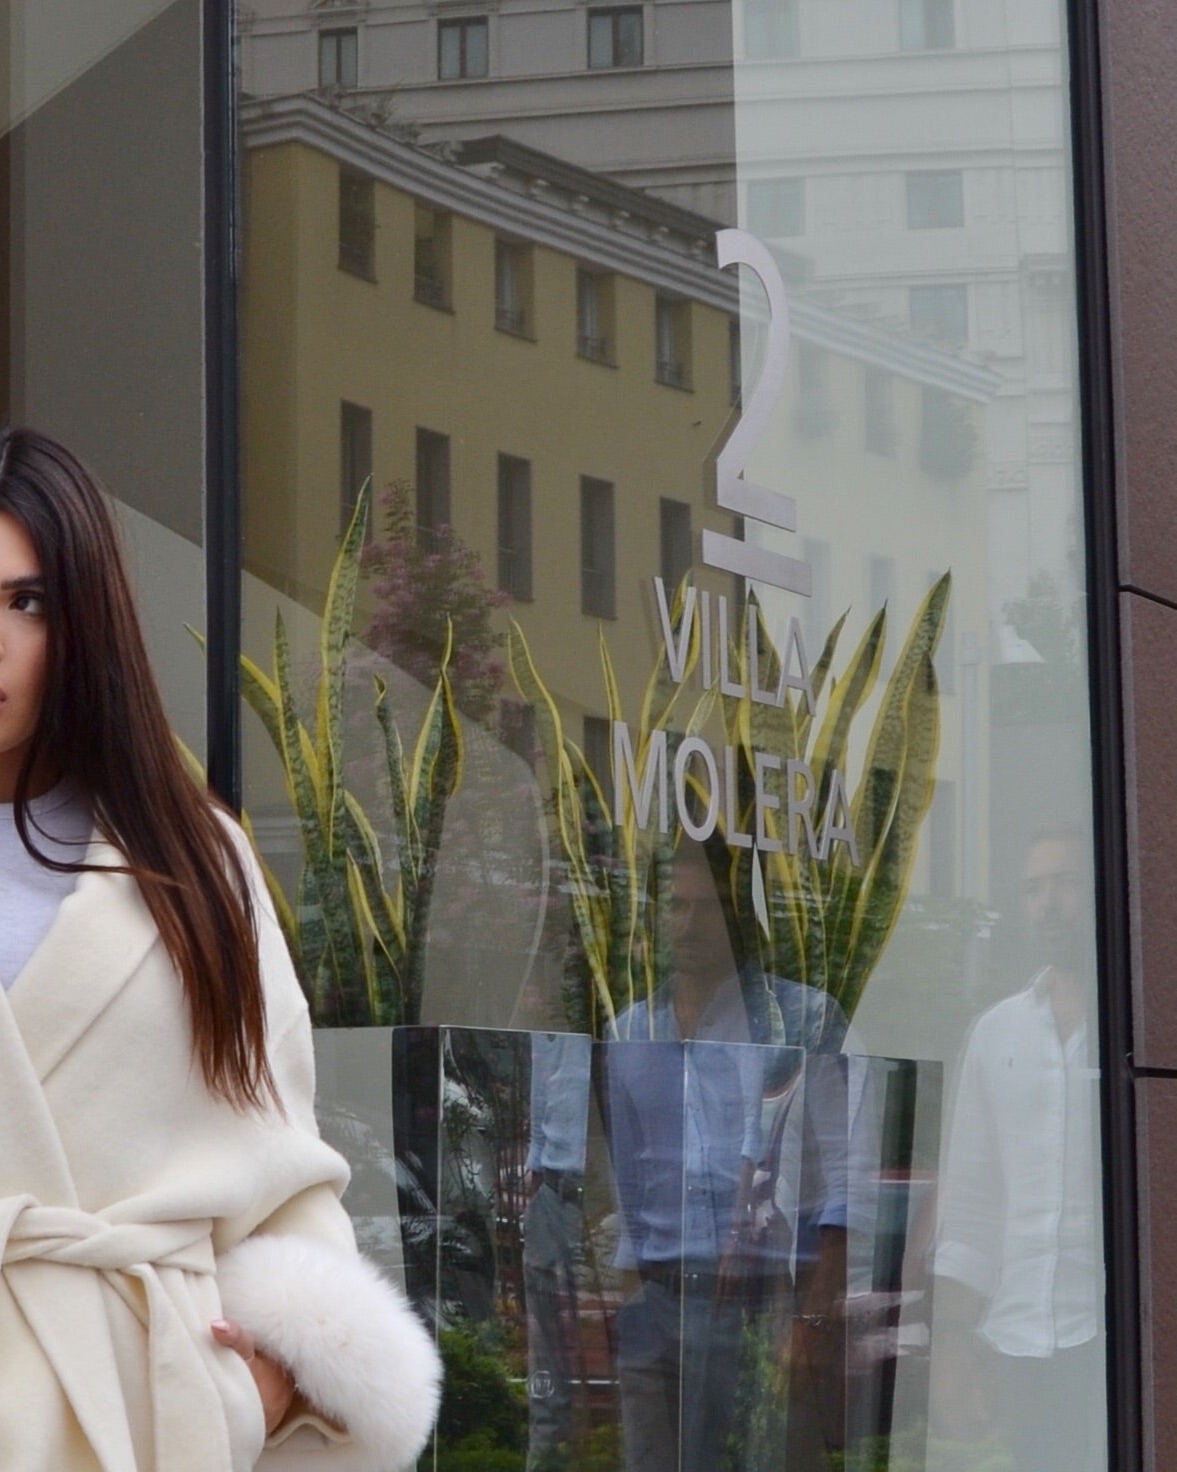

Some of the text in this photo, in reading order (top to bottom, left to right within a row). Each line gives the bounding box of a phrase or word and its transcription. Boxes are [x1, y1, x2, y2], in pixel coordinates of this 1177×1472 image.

[715, 228, 797, 532] 2
[653, 576, 816, 718] VILLA
[612, 720, 860, 868] MOLERA
